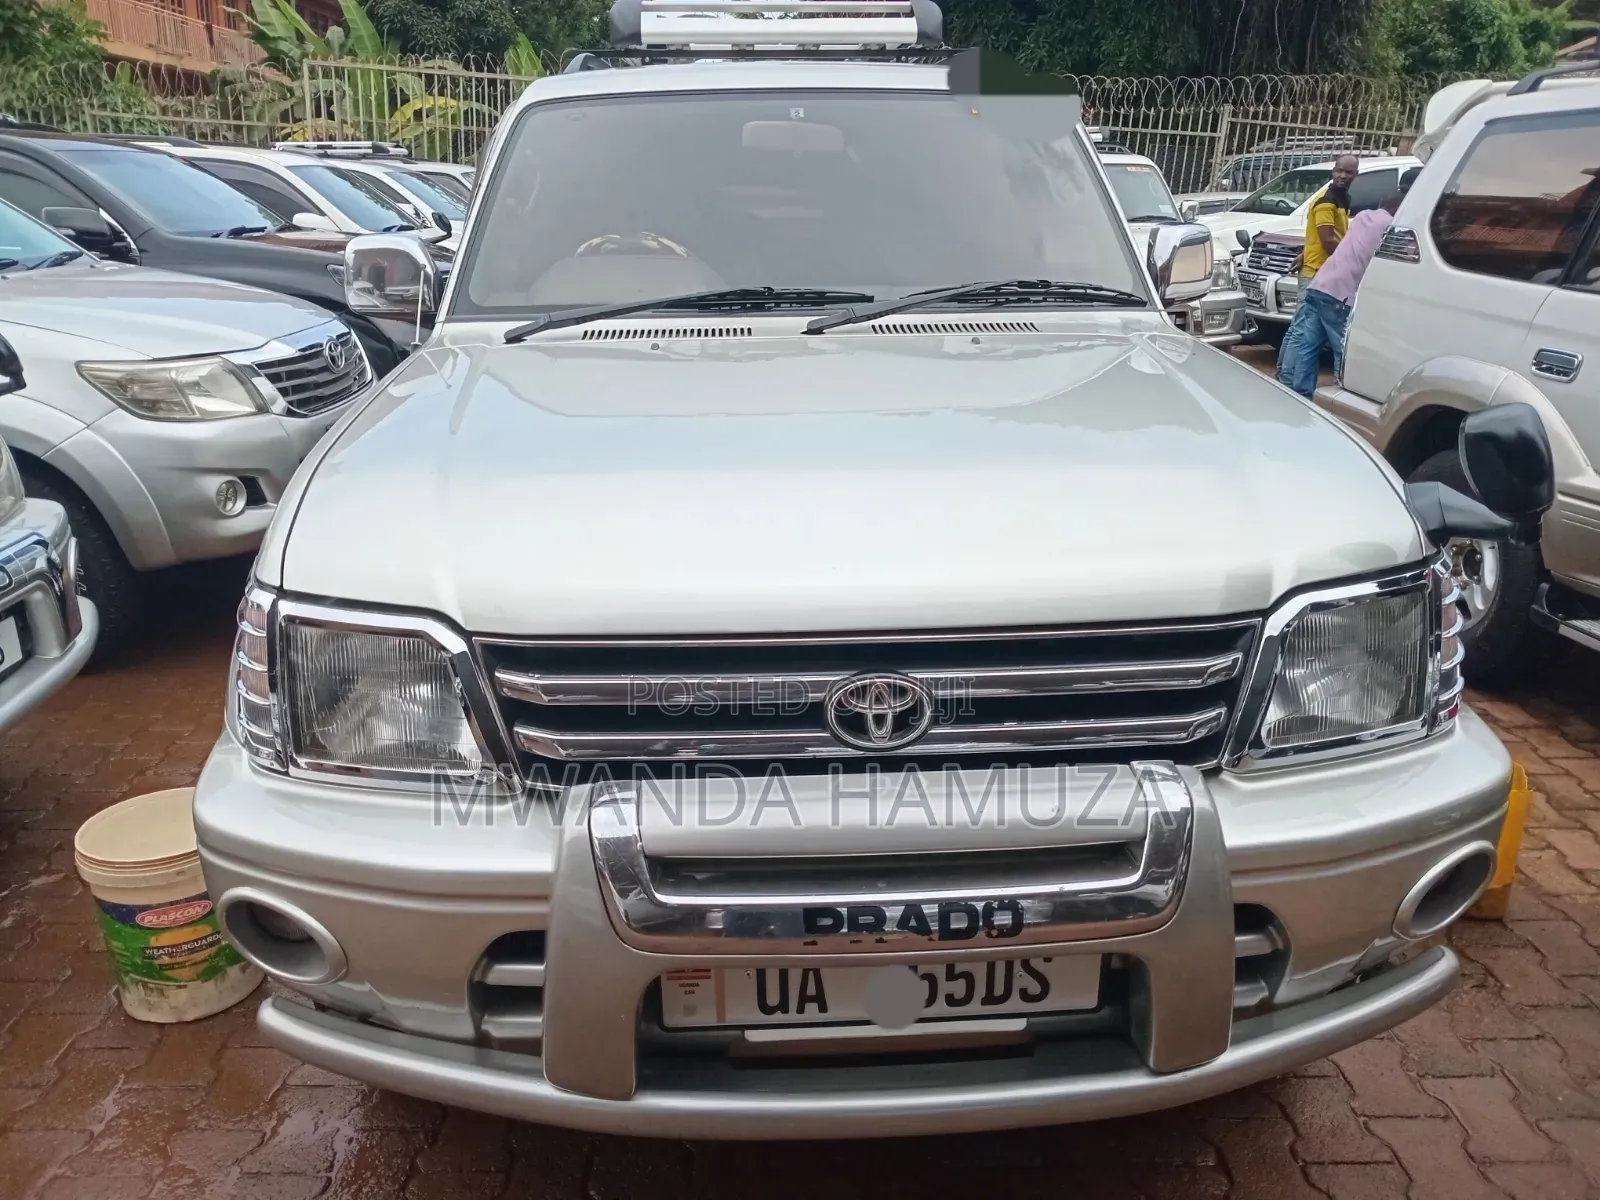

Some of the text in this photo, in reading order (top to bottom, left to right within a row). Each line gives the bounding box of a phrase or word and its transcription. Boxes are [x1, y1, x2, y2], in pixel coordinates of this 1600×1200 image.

[143, 904, 204, 924] PLASCON
[802, 899, 1024, 942] PRADO
[756, 967, 828, 1015] UA
